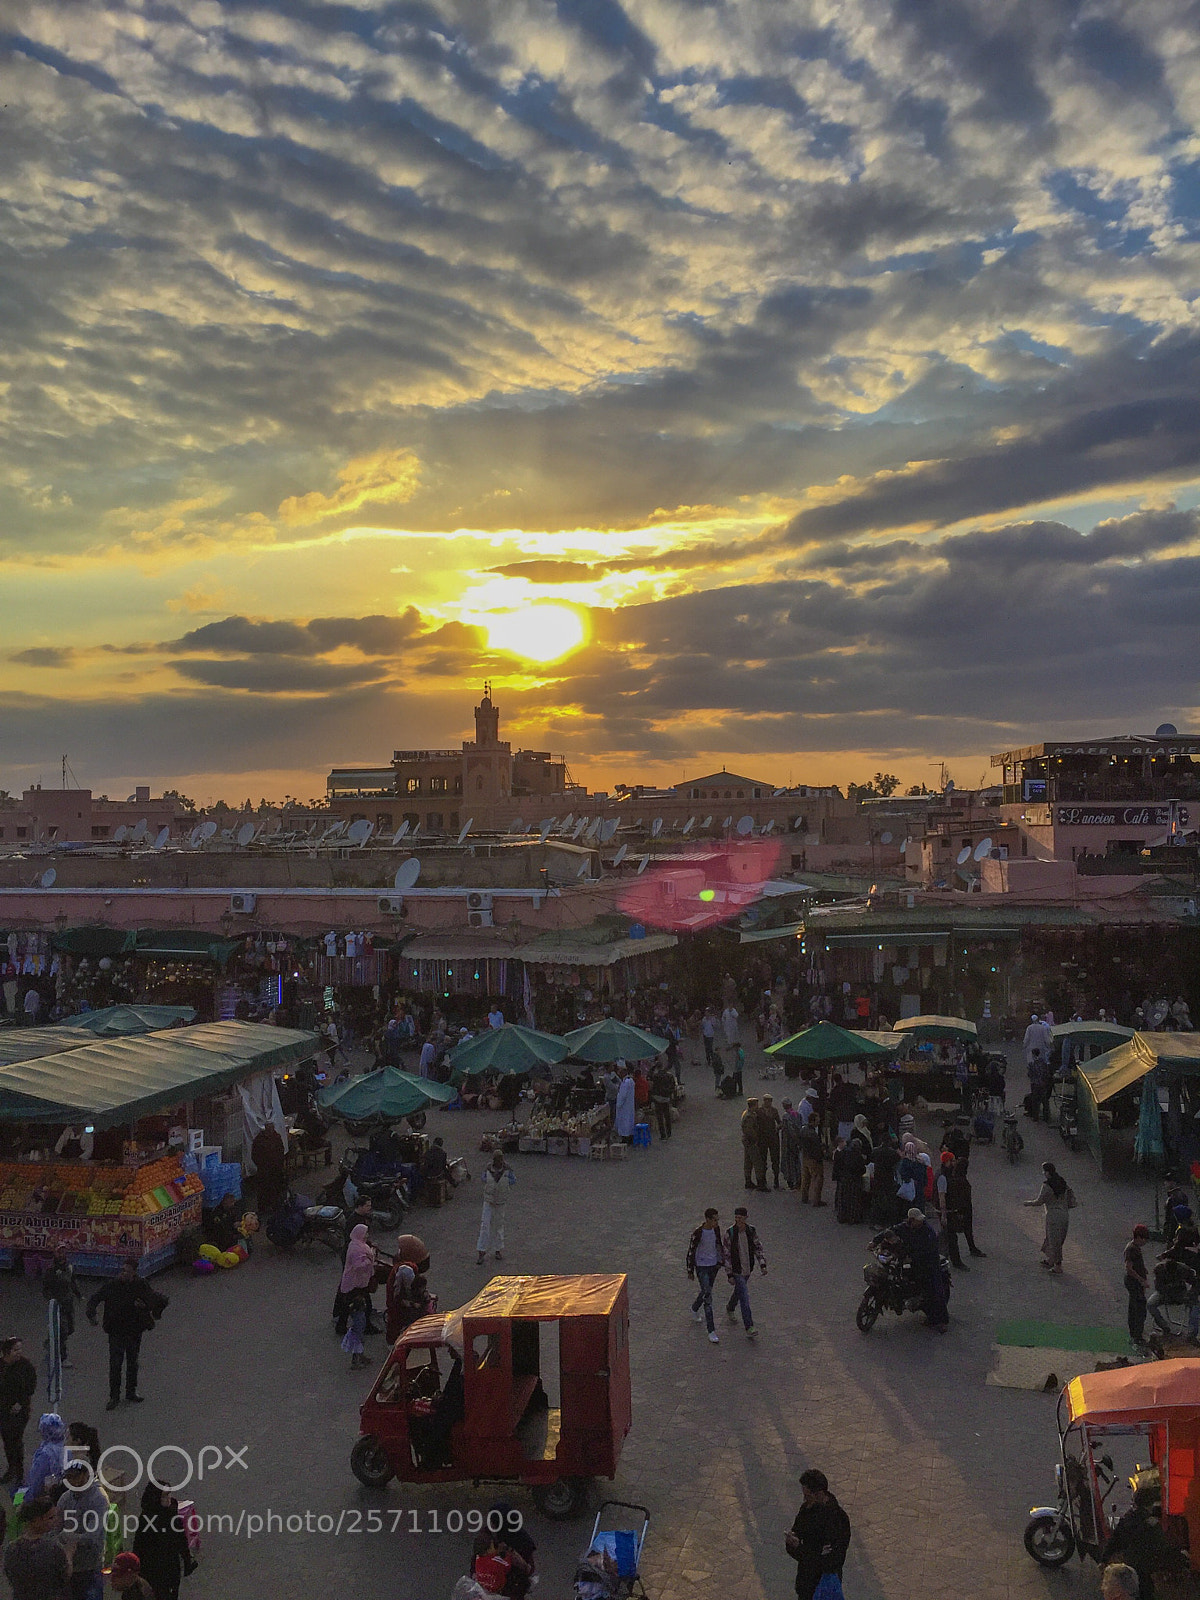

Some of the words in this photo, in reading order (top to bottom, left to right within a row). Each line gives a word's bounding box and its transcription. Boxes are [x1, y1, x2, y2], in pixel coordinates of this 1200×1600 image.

[1132, 746, 1199, 754] GLACIE
[1066, 808, 1115, 824] L'ancien
[1124, 808, 1149, 824] Café
[0, 1214, 23, 1226] hez
